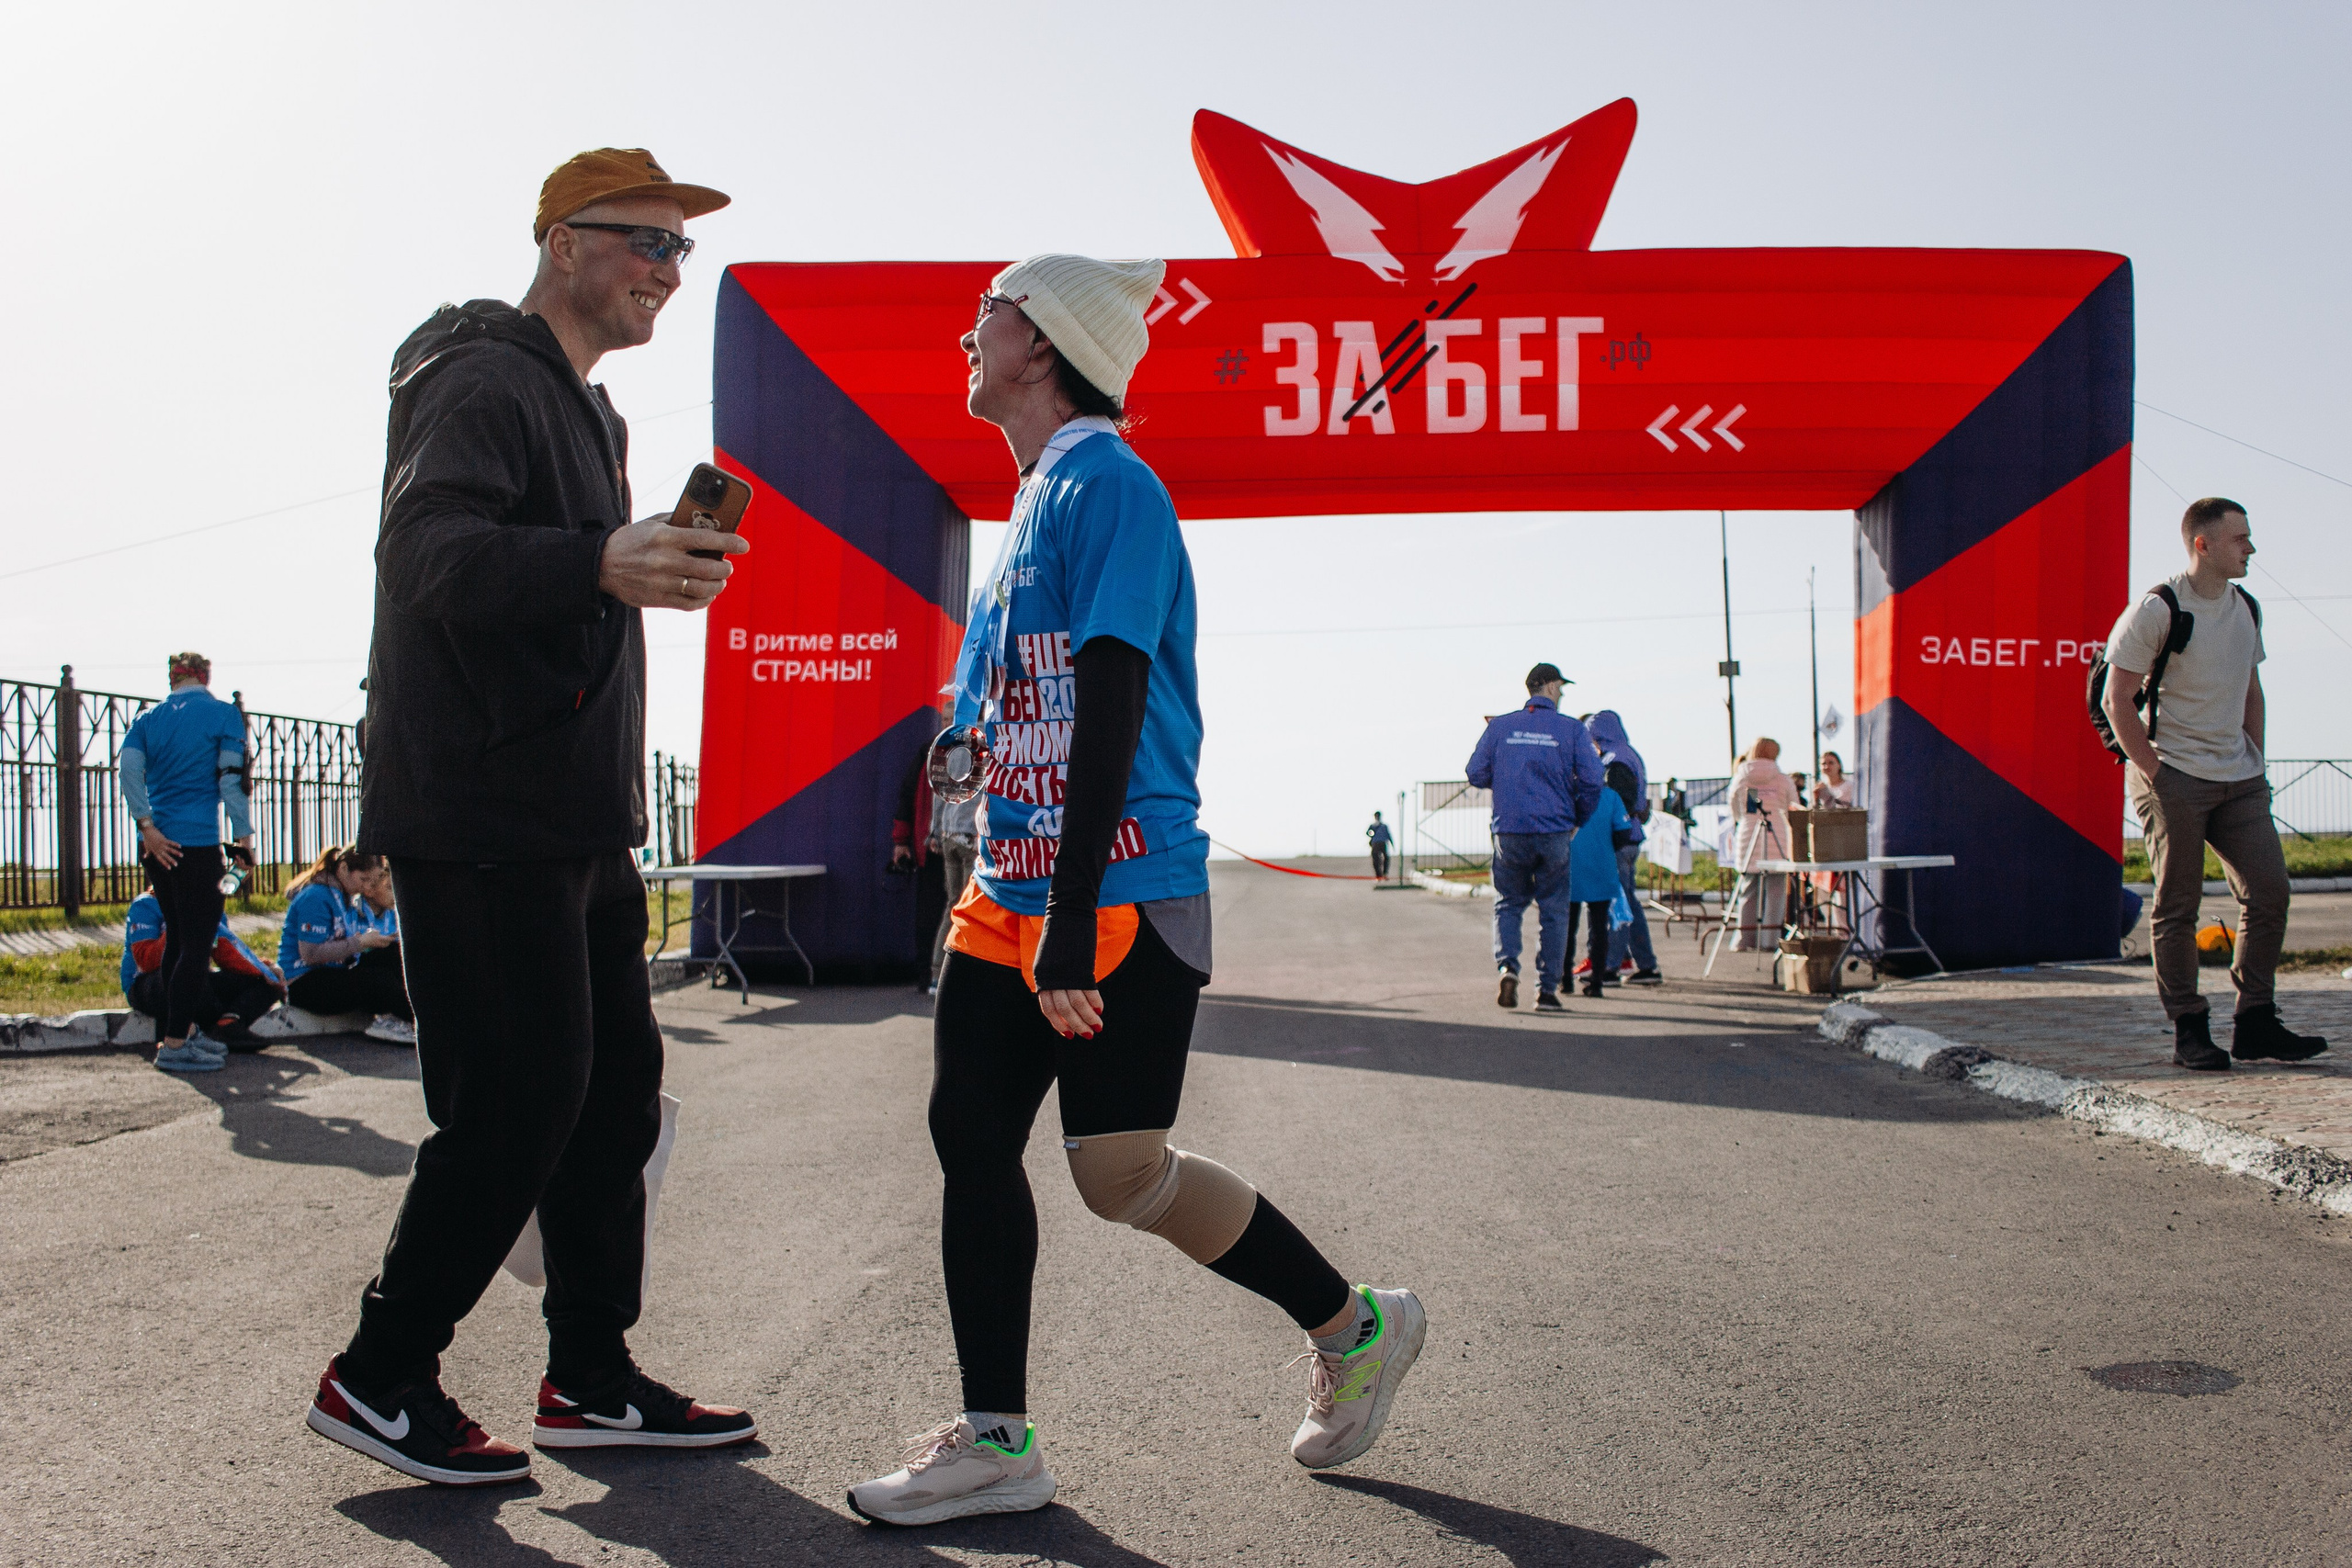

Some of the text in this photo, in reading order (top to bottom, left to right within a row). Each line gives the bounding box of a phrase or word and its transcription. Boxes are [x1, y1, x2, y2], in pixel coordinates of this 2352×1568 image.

[729, 627, 899, 655] В ритме всей
[752, 658, 872, 682] СТРАНЫ!
